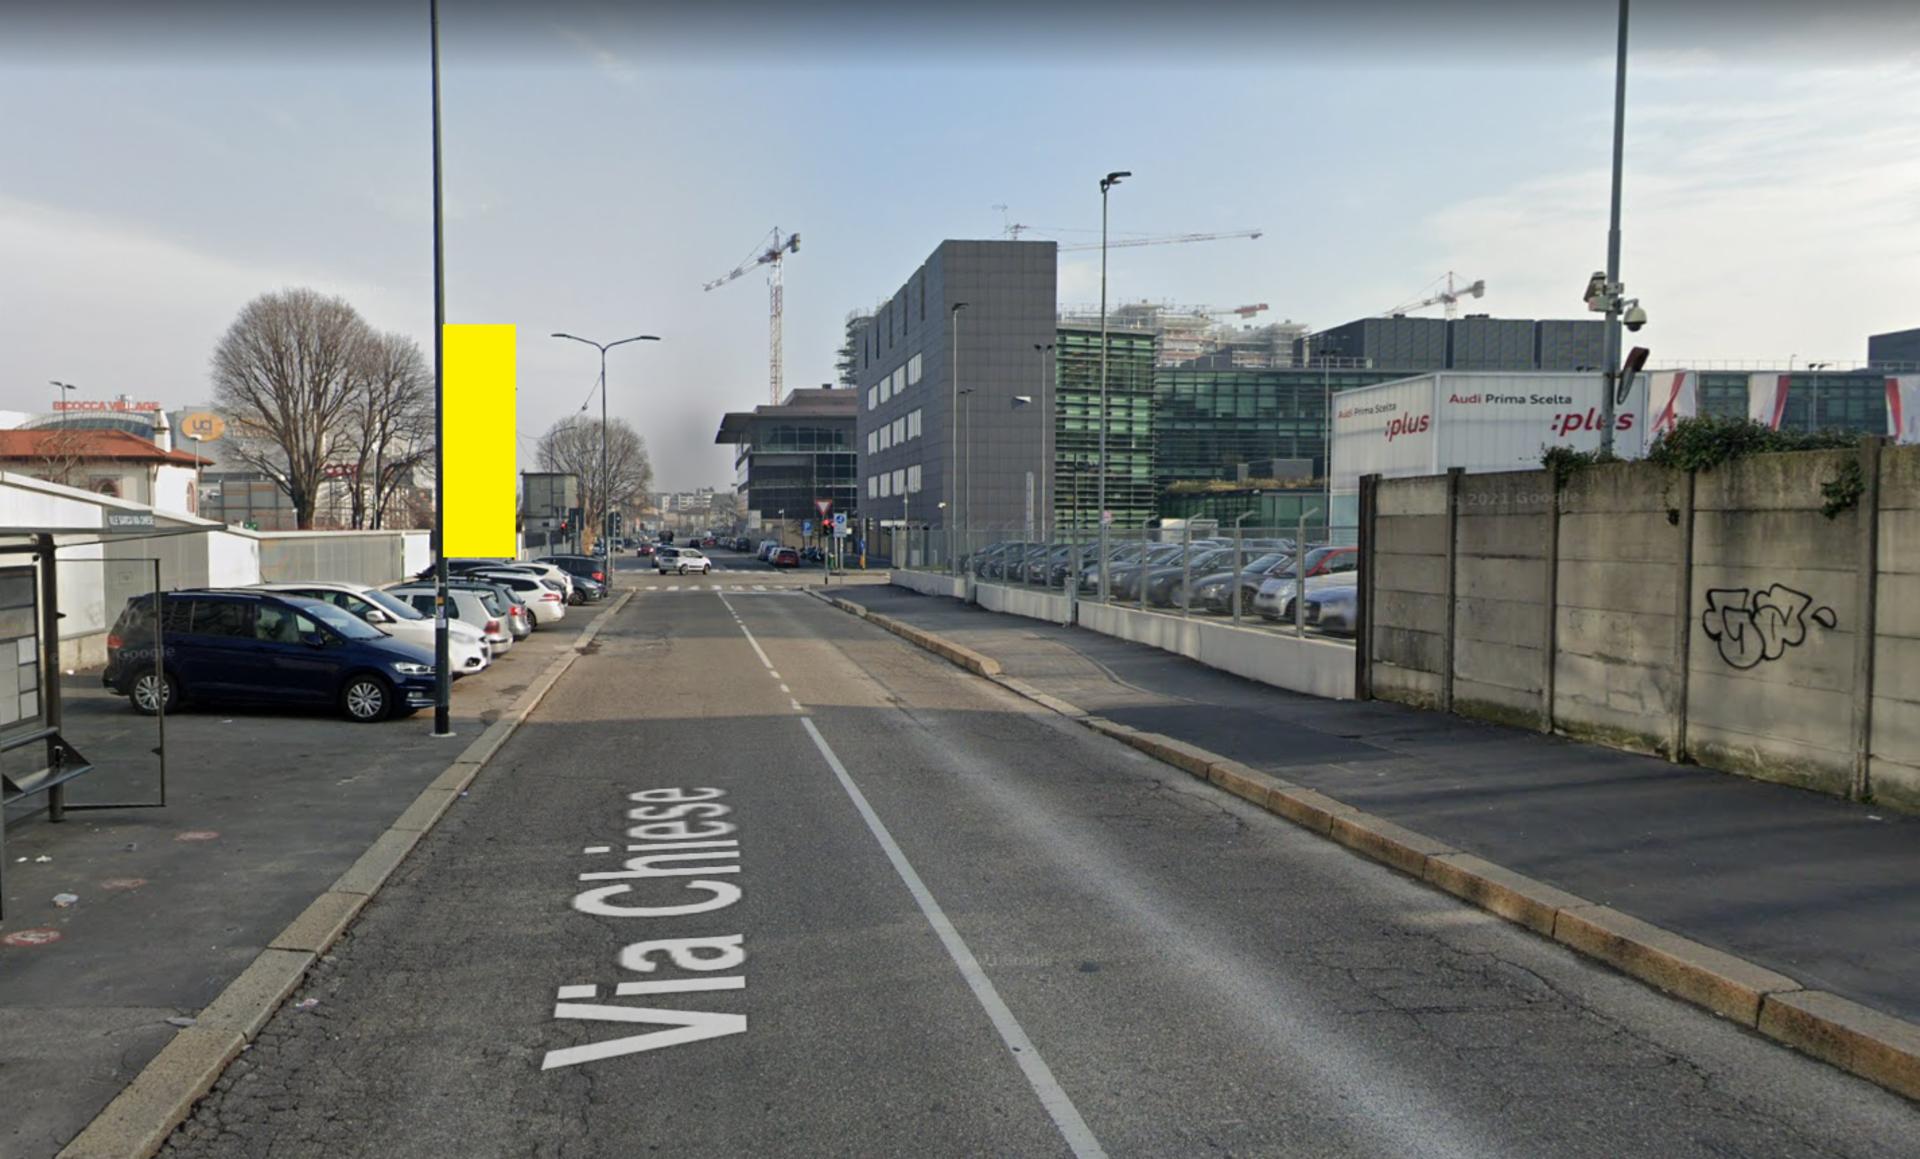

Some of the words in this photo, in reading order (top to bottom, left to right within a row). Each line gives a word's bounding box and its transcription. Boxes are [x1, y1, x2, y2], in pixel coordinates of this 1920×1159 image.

[1449, 393, 1482, 405] Audi
[1485, 393, 1526, 405] Prima
[1529, 393, 1573, 405] Scelta
[53, 401, 106, 411] BICOCCA
[1338, 408, 1353, 419] Audi
[1354, 406, 1375, 417] Prima
[1375, 402, 1397, 414] Scelta
